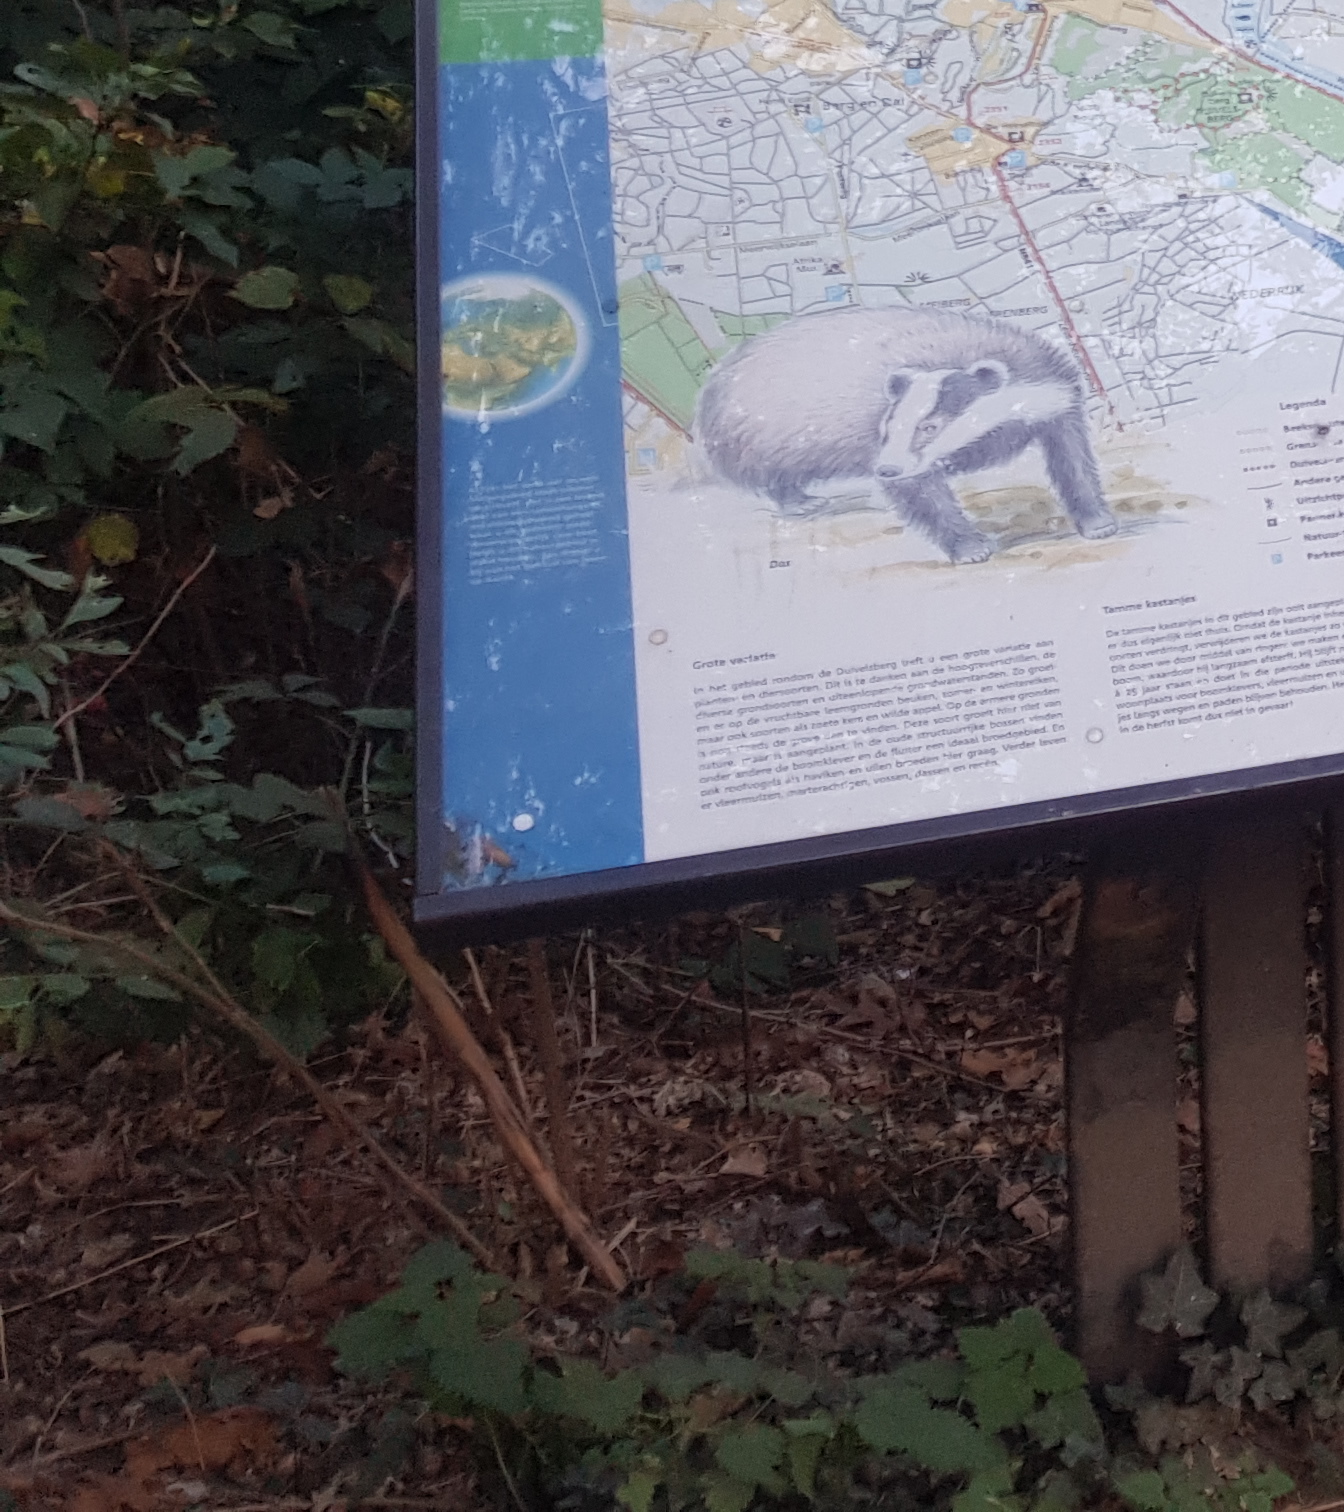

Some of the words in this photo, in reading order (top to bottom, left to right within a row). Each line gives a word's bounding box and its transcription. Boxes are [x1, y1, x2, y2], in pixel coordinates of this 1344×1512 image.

[1279, 399, 1326, 411] Legenda
[693, 659, 726, 669] Grote
[772, 673, 814, 684] rondom
[818, 670, 832, 678] de
[963, 649, 990, 661] grote
[932, 667, 945, 675] de
[1043, 652, 1056, 660] de
[747, 717, 760, 725] de
[773, 739, 787, 747] de
[869, 738, 882, 746] de
[775, 764, 789, 772] de
[875, 750, 888, 758] de
